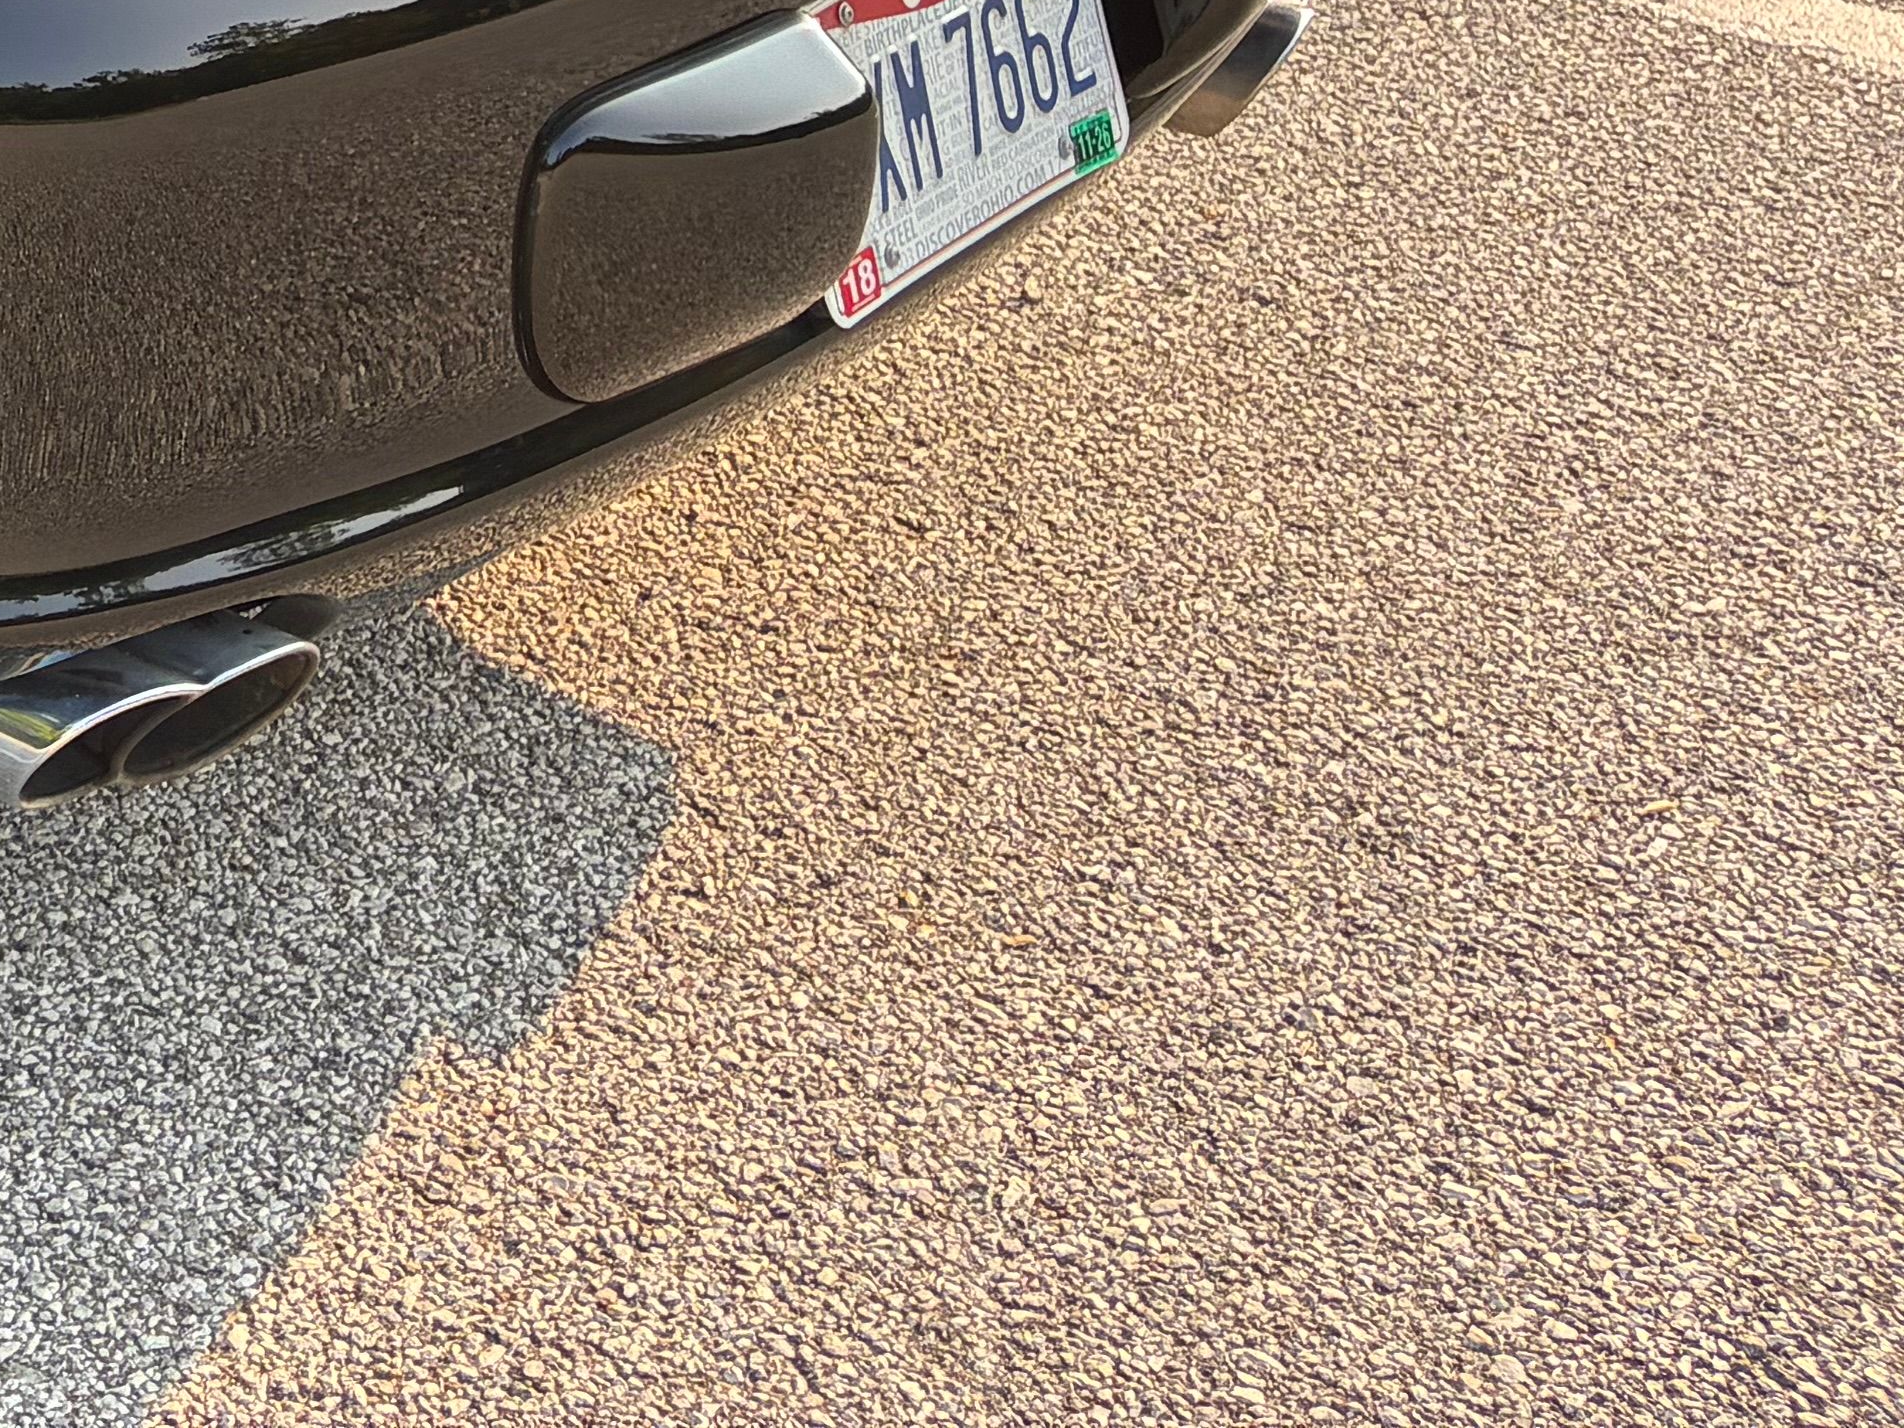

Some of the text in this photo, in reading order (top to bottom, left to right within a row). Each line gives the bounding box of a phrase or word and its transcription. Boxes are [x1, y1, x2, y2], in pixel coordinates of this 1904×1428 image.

[863, 4, 941, 57] BIRTHPLACE
[918, 164, 1051, 258] DISCOVEROHIO.COM
[843, 258, 878, 304] 18
